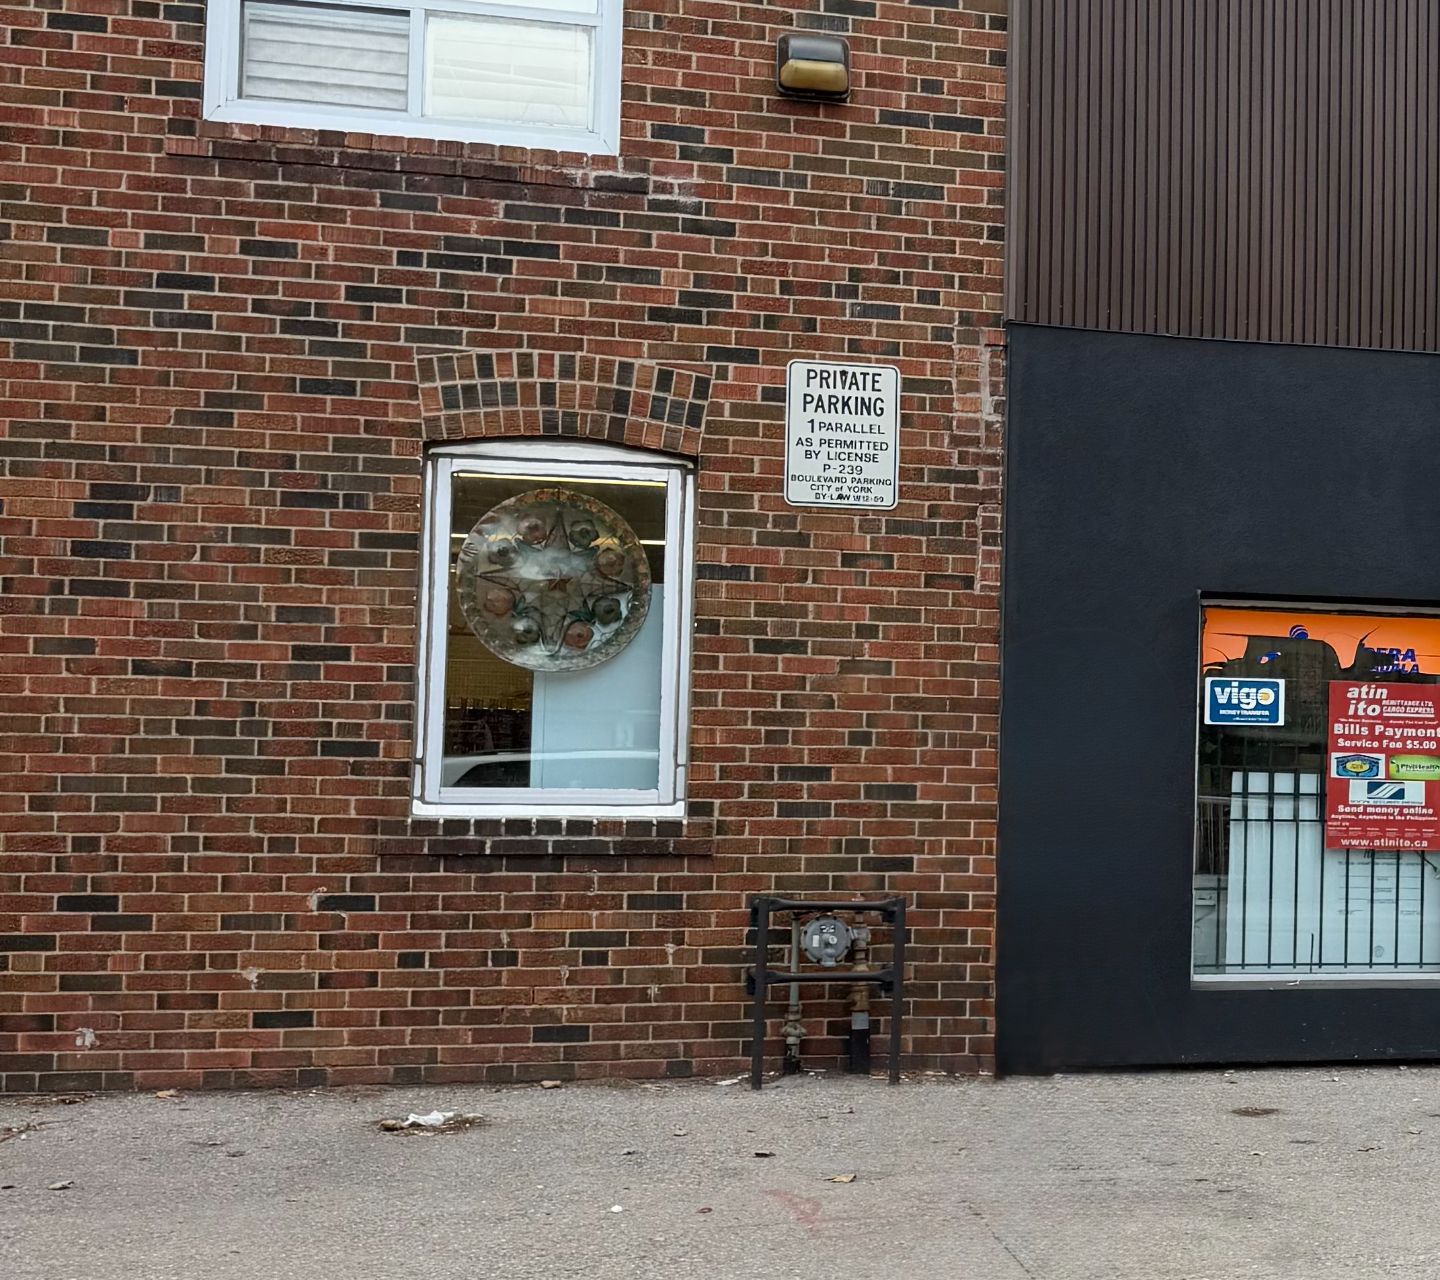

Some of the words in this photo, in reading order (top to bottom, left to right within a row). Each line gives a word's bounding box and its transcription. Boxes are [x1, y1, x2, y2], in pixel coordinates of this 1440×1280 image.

[806, 368, 882, 392] PRIVATE
[802, 393, 885, 417] PARKING
[807, 419, 815, 433] 1
[818, 421, 886, 435] PARALLEL
[795, 437, 813, 447] AS
[819, 438, 889, 452] PERMITTED
[804, 450, 821, 460] BY
[827, 451, 880, 463] LICENSE
[823, 464, 863, 475] P-239
[790, 474, 848, 484] BOULEVARD
[851, 477, 892, 487] PARKING
[810, 483, 832, 492] CITY
[847, 485, 873, 494] YORK
[1213, 681, 1275, 710] vigo
[1346, 684, 1388, 699] atin
[1348, 700, 1380, 716] ito
[1333, 723, 1369, 735] Bills
[1337, 738, 1379, 748] Service
[1382, 739, 1402, 749] Fee
[1406, 740, 1437, 750] $5.00
[1338, 805, 1363, 813] Send
[1367, 806, 1399, 816] money
[1403, 806, 1434, 815] online
[1340, 838, 1428, 848] www.atinito.ca
